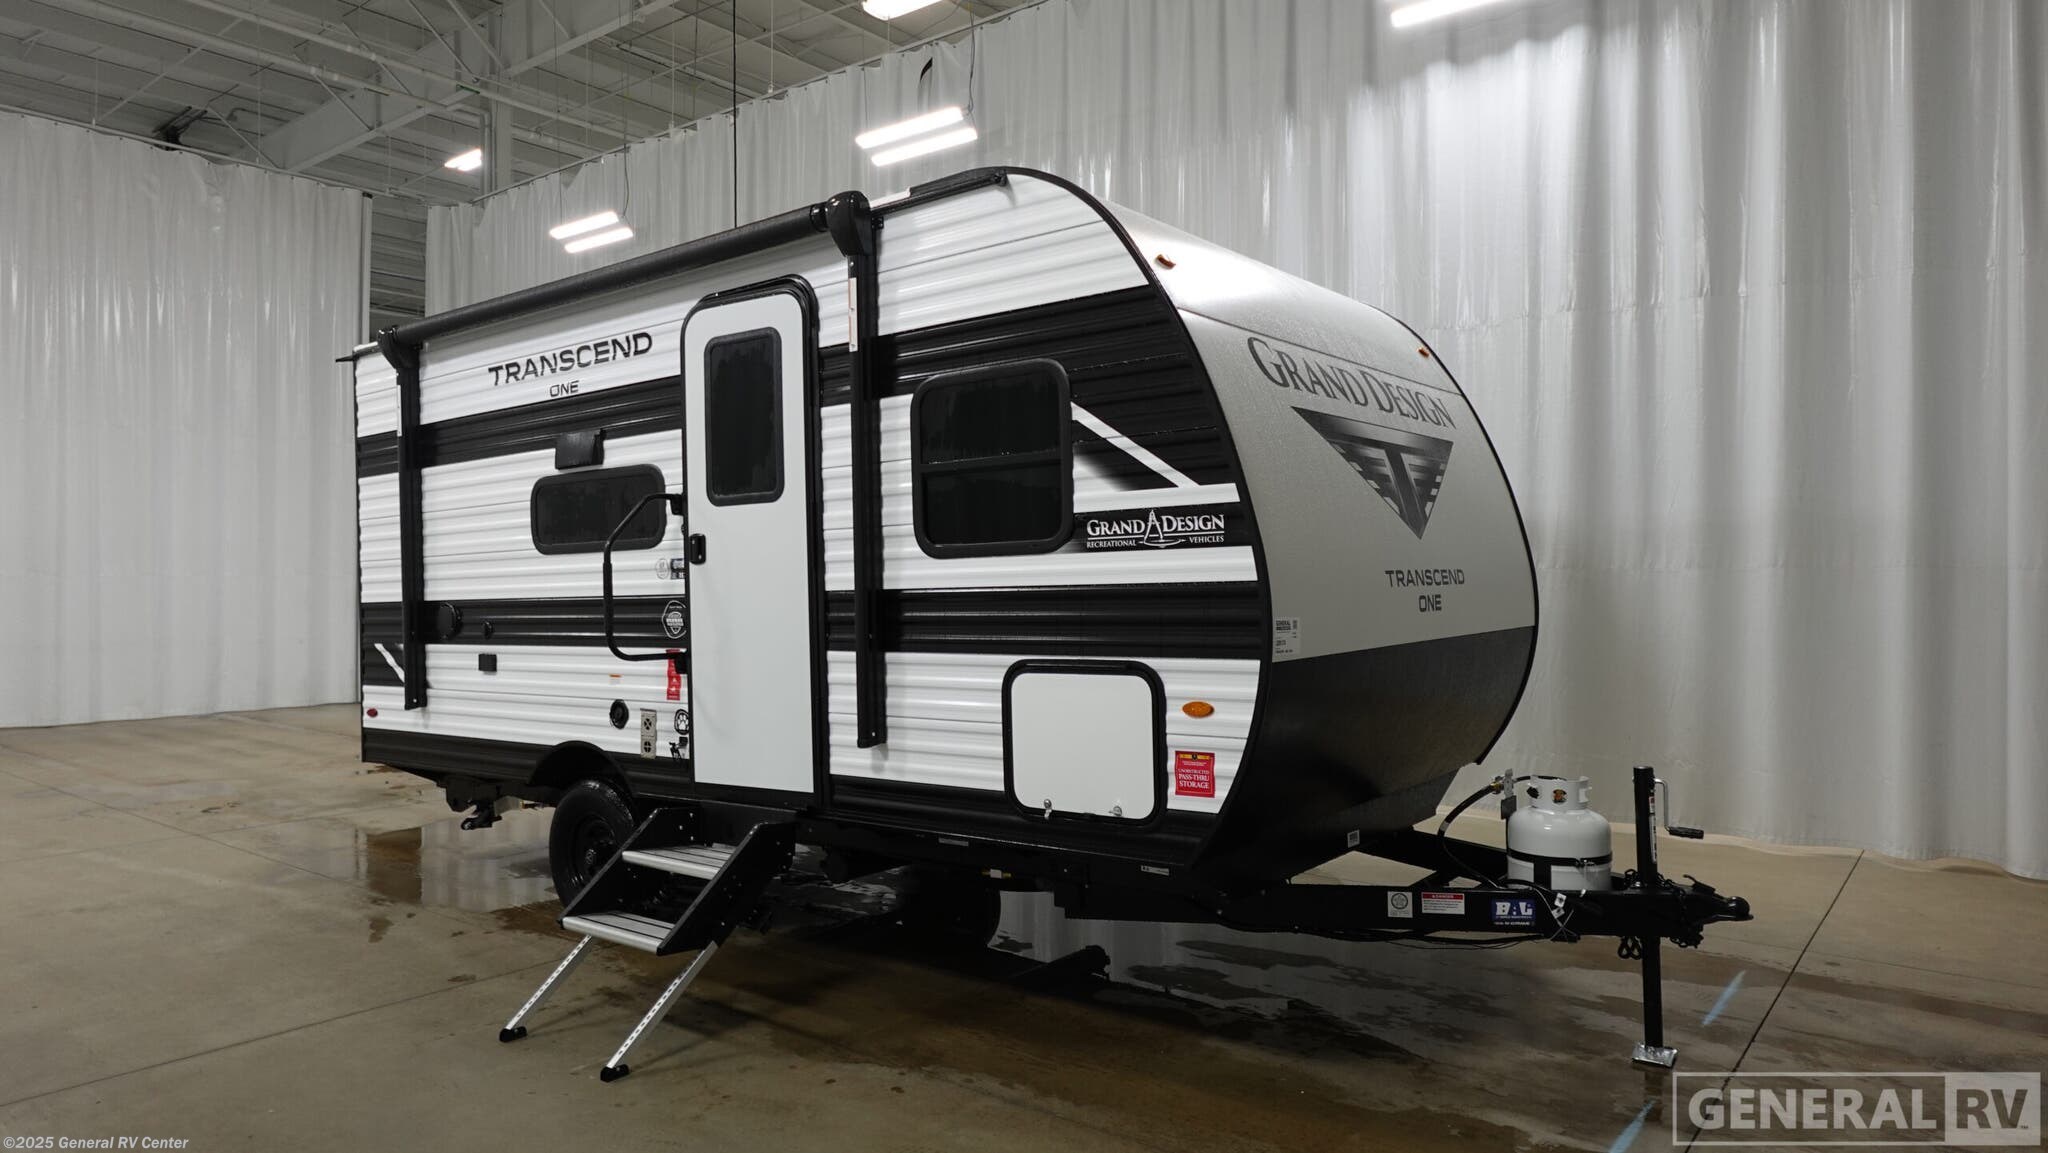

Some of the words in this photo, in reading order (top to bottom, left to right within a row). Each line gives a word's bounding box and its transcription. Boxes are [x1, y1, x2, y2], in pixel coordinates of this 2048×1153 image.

[488, 331, 653, 387] TRANSCEND
[549, 380, 579, 398] ONE
[1247, 336, 1368, 407] GRAND
[1362, 371, 1457, 430] DESIGN
[1086, 519, 1146, 536] GRAND
[1161, 514, 1225, 533] DESIGN
[1086, 539, 1137, 549] RECREATIONAL
[1189, 535, 1225, 544] VEHICLES
[1385, 568, 1465, 588] TRANSCEND
[1418, 594, 1442, 612] ONE
[1178, 773, 1209, 781] PASS-THRU
[1179, 780, 1209, 789] STORAGE
